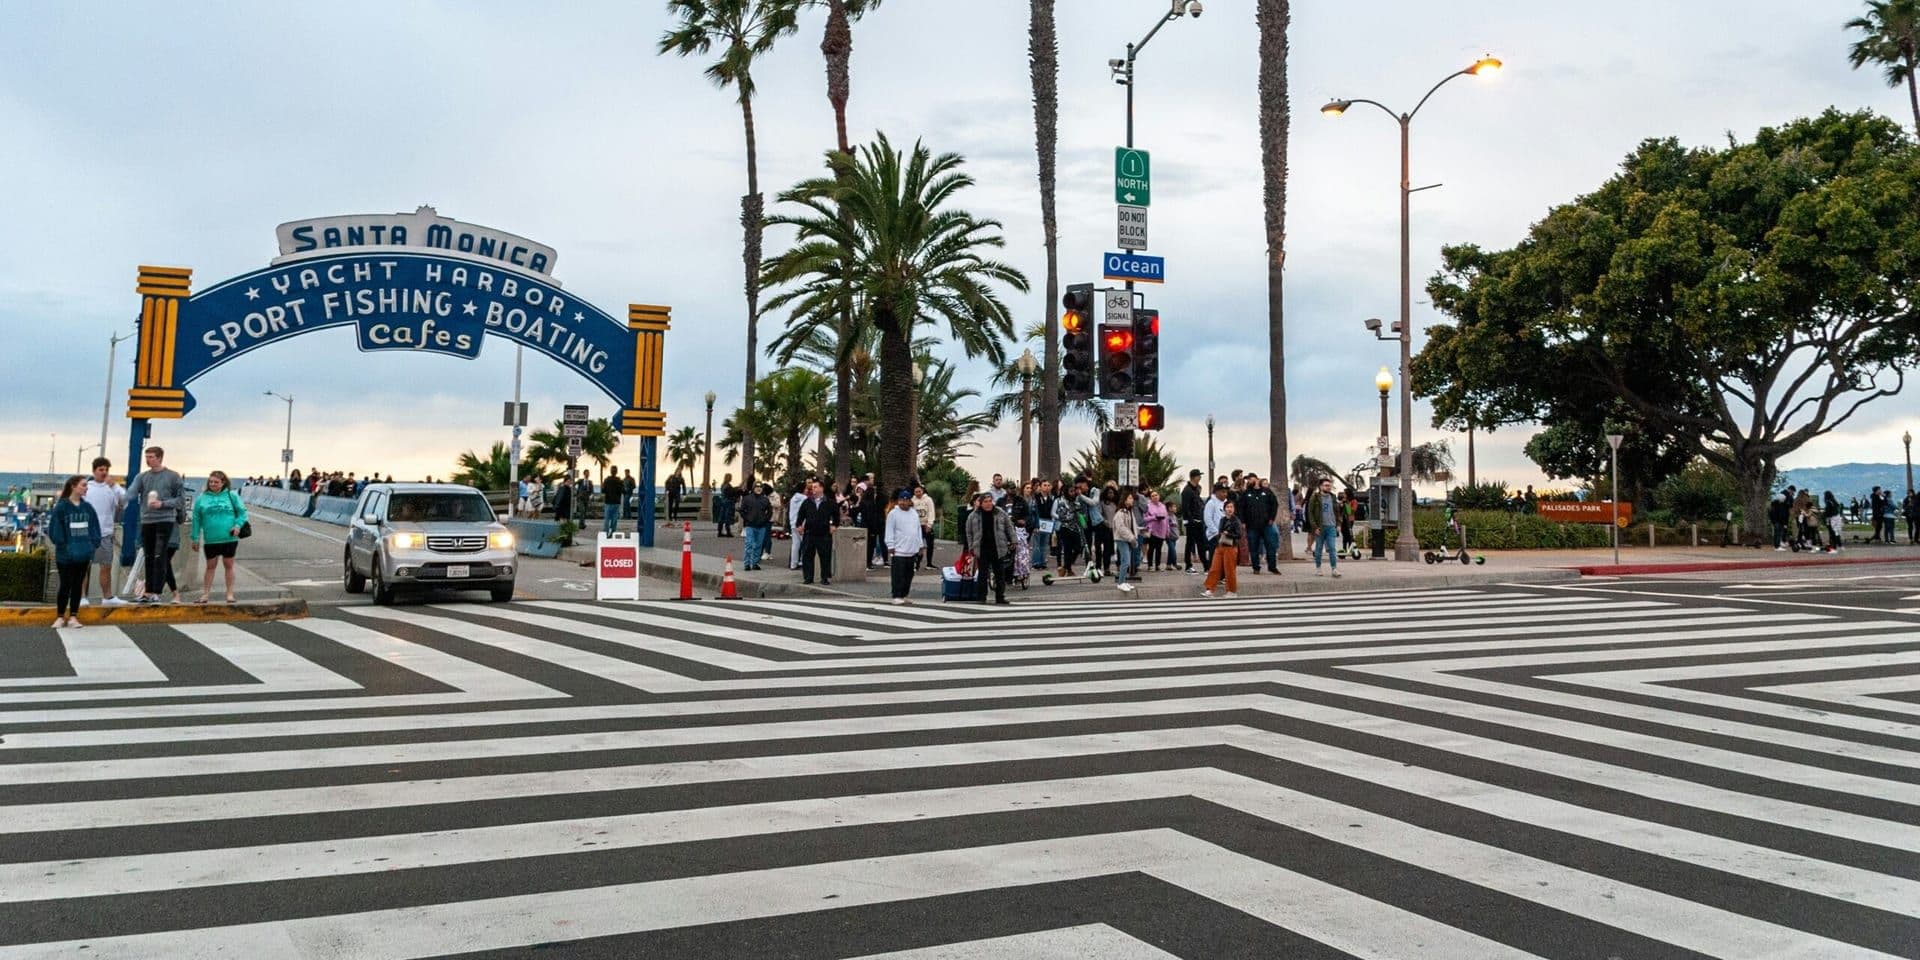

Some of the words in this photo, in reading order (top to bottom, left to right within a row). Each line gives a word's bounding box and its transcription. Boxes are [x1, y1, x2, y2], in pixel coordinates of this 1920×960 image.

[1131, 159, 1135, 172] 1
[1117, 177, 1149, 190] NORTH
[1119, 211, 1130, 221] DO
[1131, 212, 1145, 223] NOT
[1119, 225, 1145, 236] BLOCK
[292, 225, 407, 252] SANTA
[427, 224, 548, 273] MONICA
[1109, 256, 1160, 274] Ocean
[271, 261, 398, 295] YACHT
[426, 263, 565, 316] HARBOR
[1107, 311, 1130, 320] SIGNAL
[202, 298, 306, 357] SPORT
[322, 288, 452, 320] FISHING
[485, 301, 609, 373] BOATING
[368, 319, 472, 350] cafes
[1541, 504, 1580, 512] PALISADES
[603, 559, 634, 568] CLOSED
